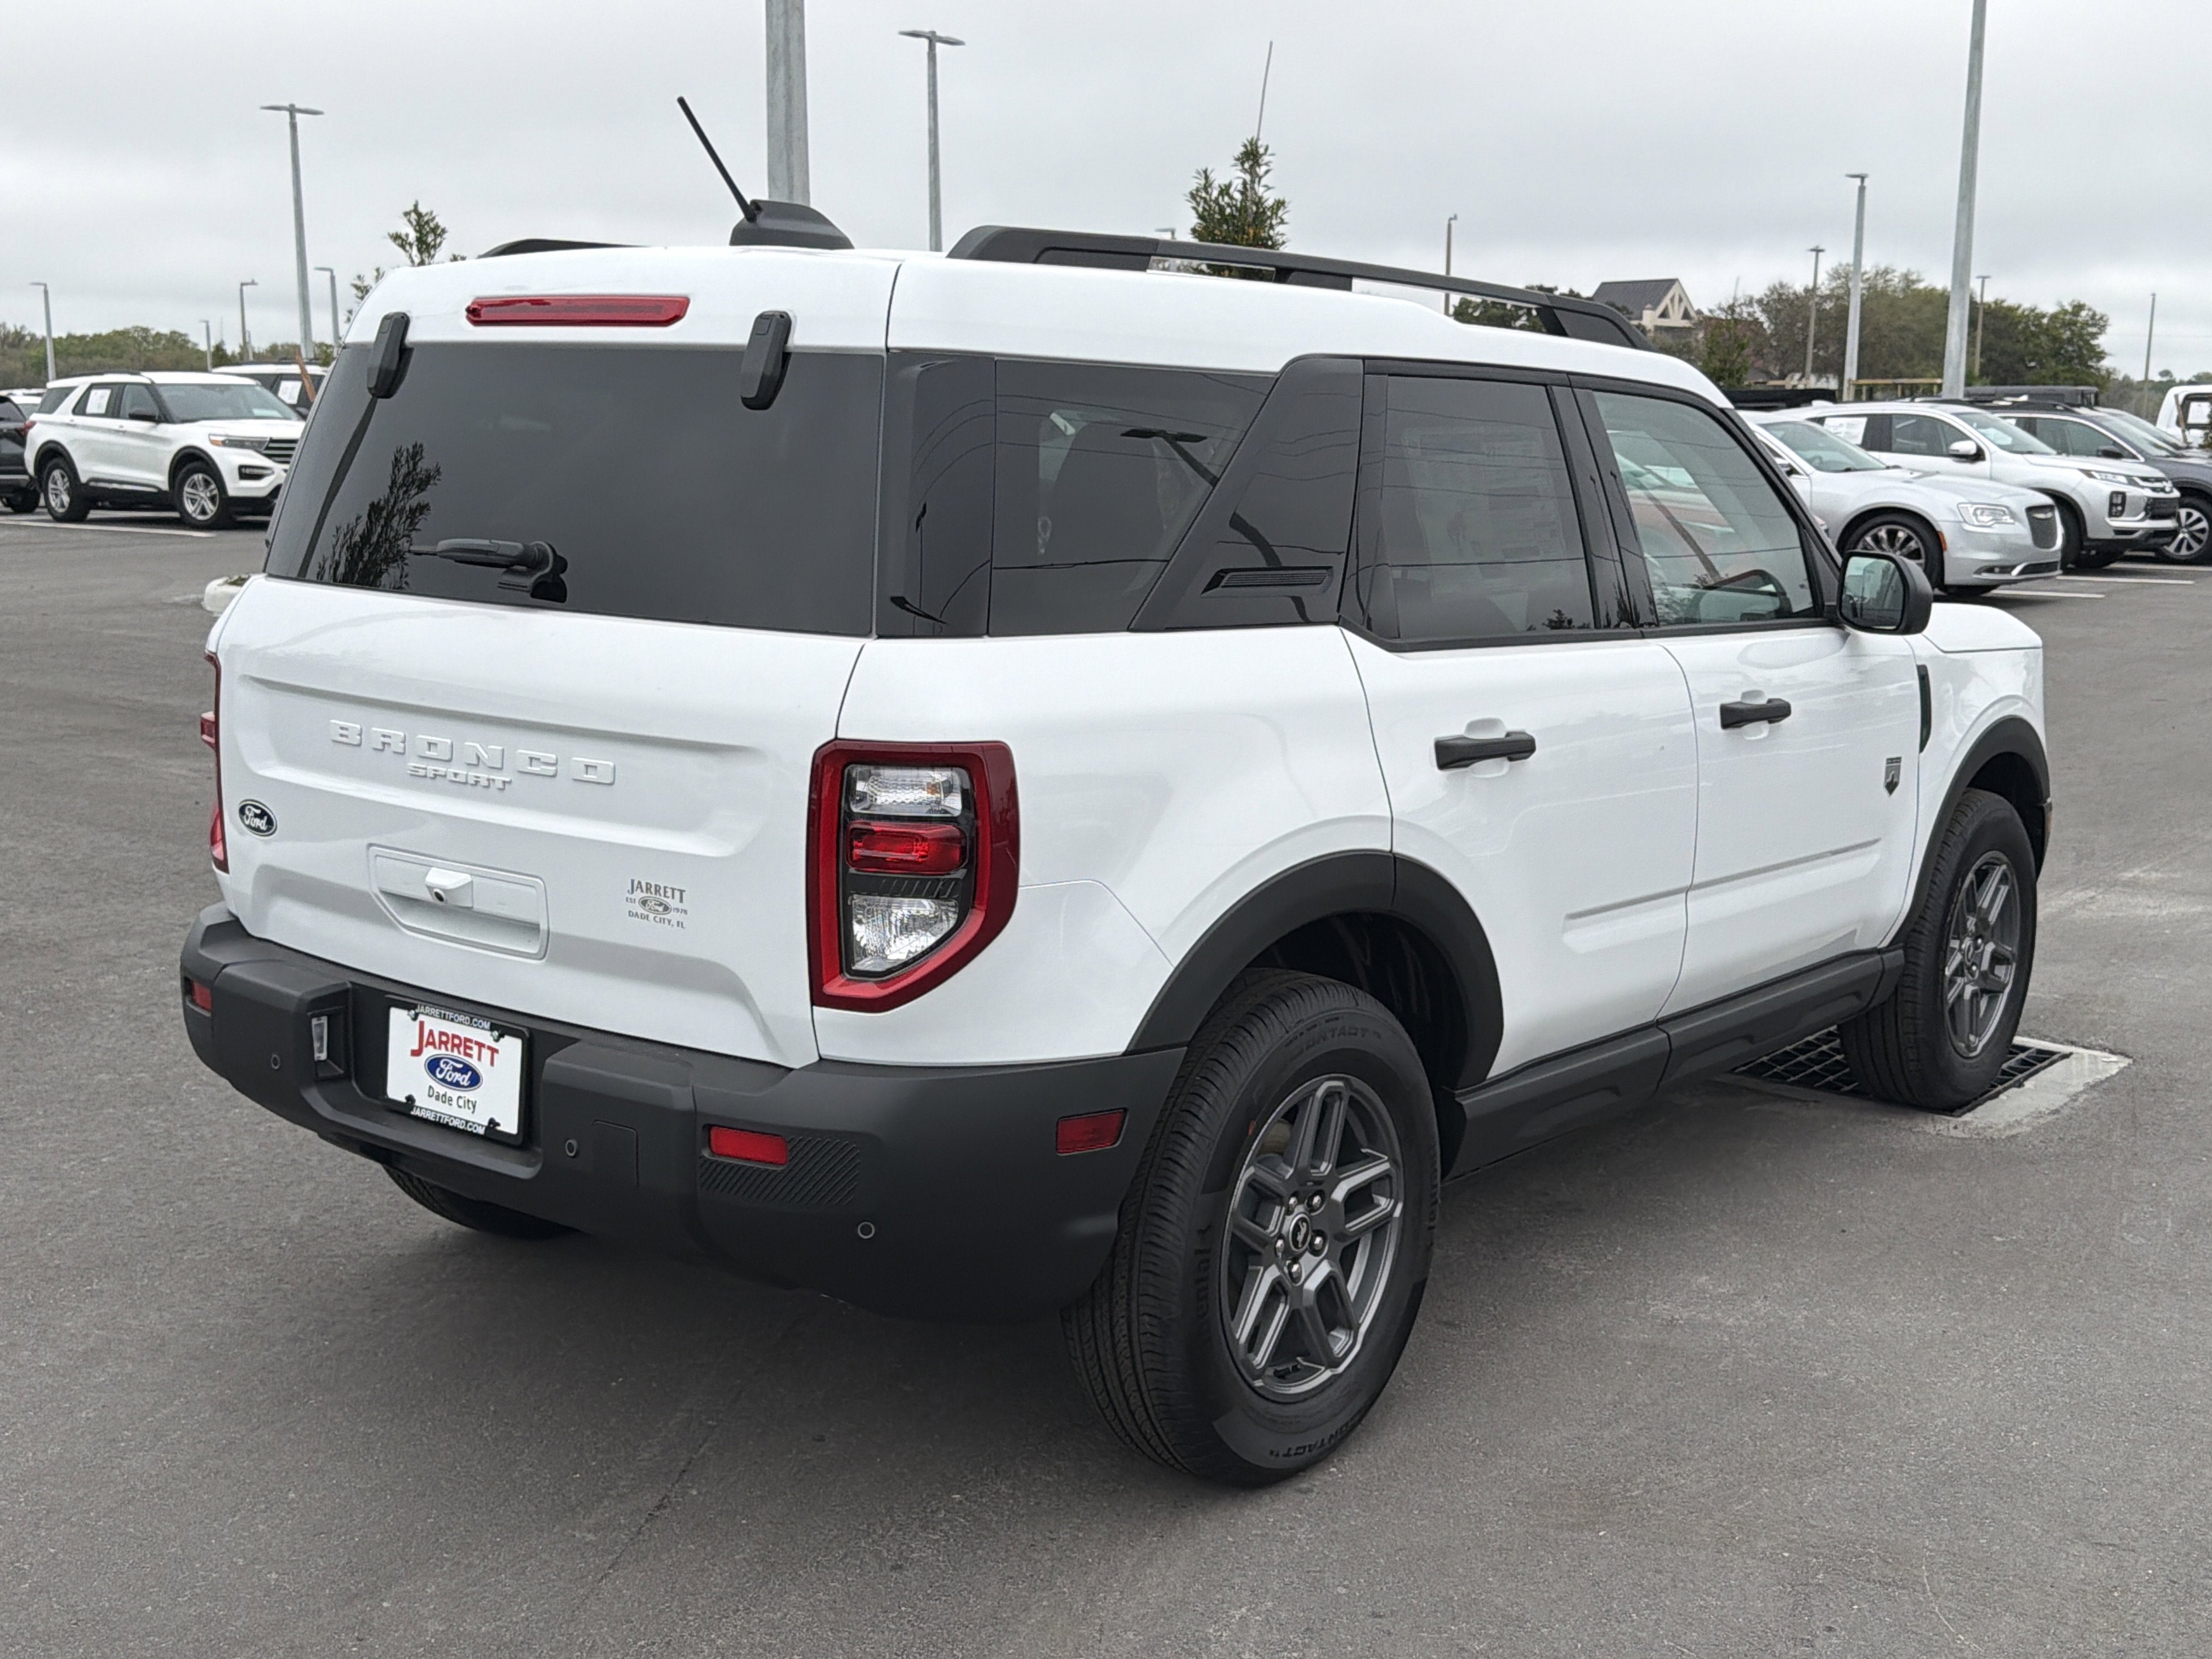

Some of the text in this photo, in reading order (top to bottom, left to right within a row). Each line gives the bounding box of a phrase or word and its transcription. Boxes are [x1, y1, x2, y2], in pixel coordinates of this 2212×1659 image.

[329, 719, 616, 786] BRONCO
[407, 763, 512, 790] SPORT
[627, 878, 686, 904] JARRETT
[628, 910, 685, 929] DADE CITY, FL
[415, 1004, 491, 1029] JARRETTFORD.COM
[410, 1020, 499, 1067] JARRETT
[436, 1058, 471, 1086] Ford
[427, 1085, 477, 1114] Dade City
[410, 1106, 486, 1135] JARRETTFORD.COM
